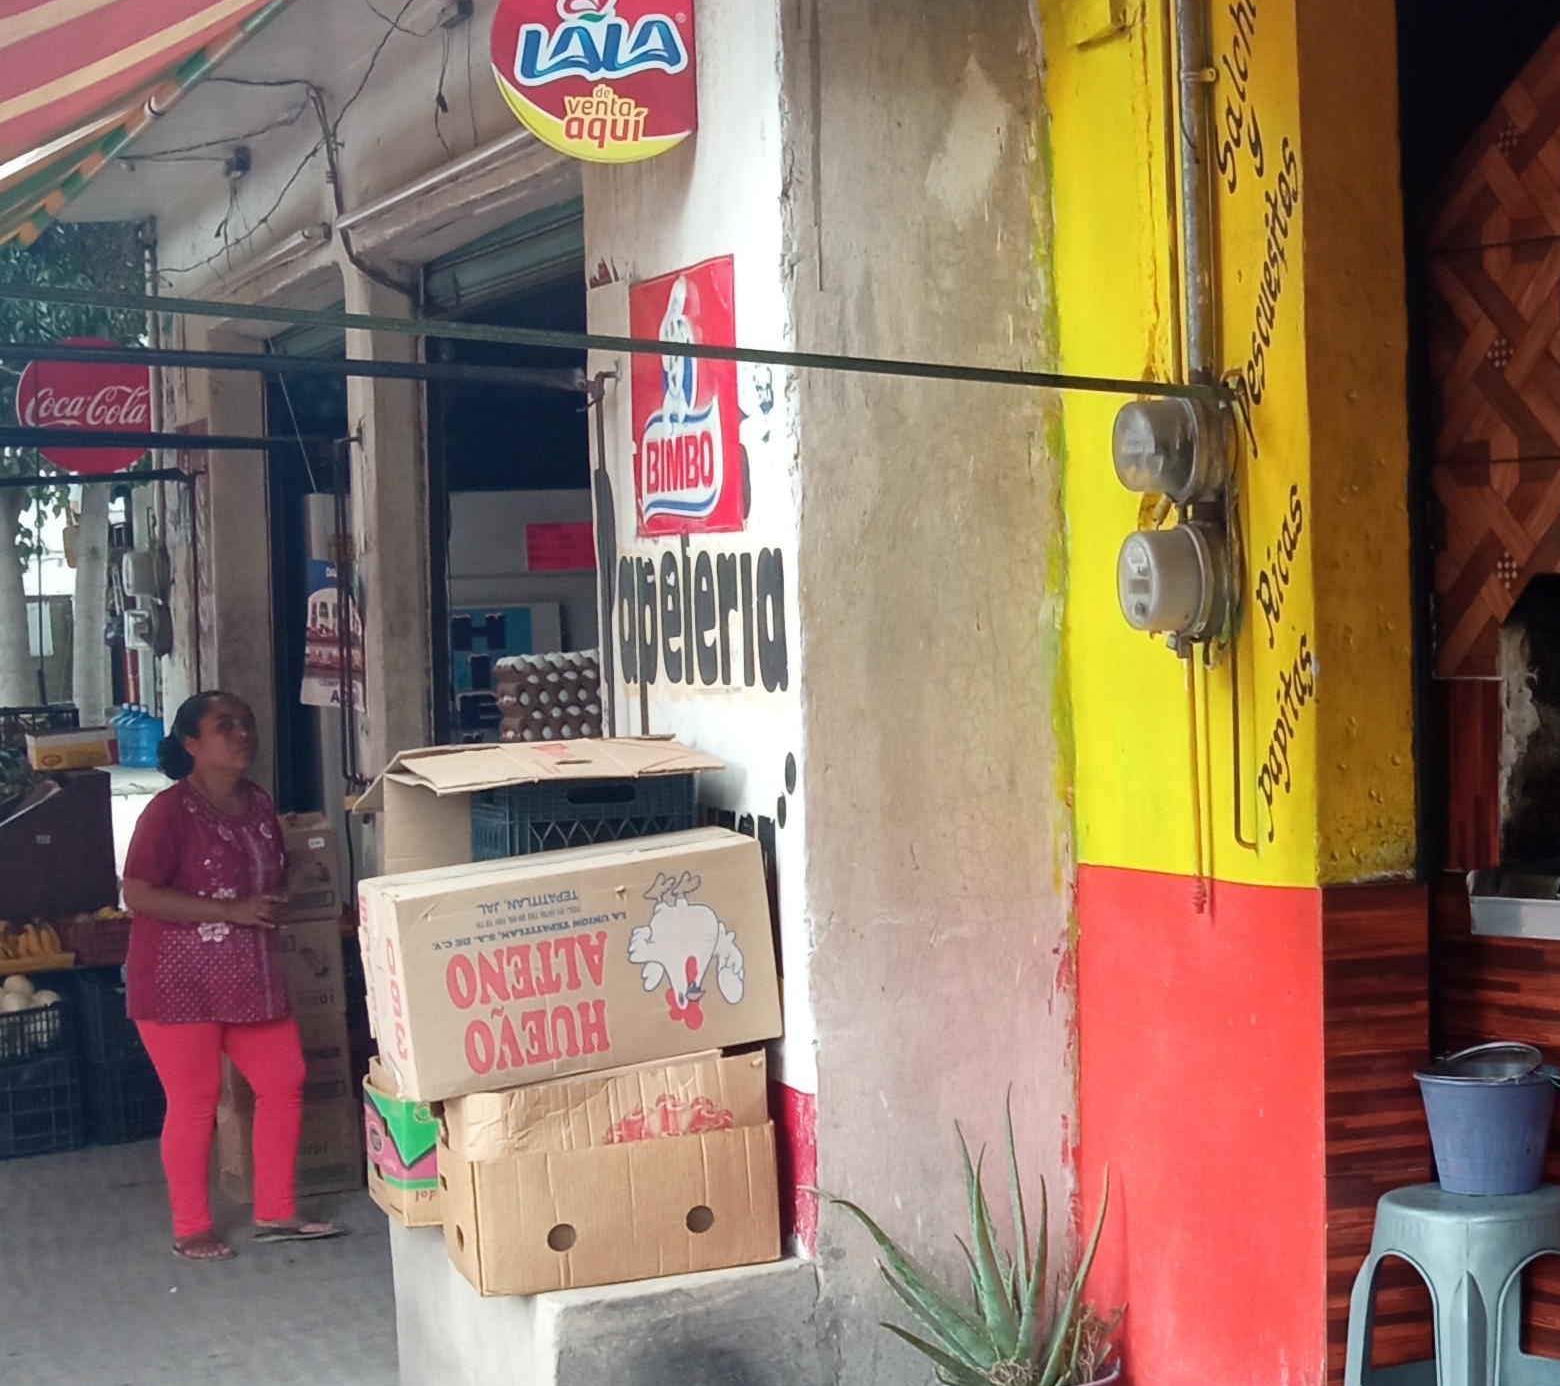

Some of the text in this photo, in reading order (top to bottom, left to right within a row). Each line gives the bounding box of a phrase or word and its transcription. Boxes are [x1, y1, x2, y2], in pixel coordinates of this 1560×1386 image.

[516, 16, 686, 84] LALA
[566, 97, 633, 117] venta
[594, 86, 612, 99] de
[564, 110, 646, 149] aquí
[646, 429, 714, 495] BIMBO
[1256, 484, 1303, 650] Ricas
[572, 914, 609, 928] UNION
[611, 912, 627, 921] LA
[455, 937, 472, 948] DE
[446, 930, 608, 1019] ALTEÑO
[464, 999, 611, 1075] HUEVO
